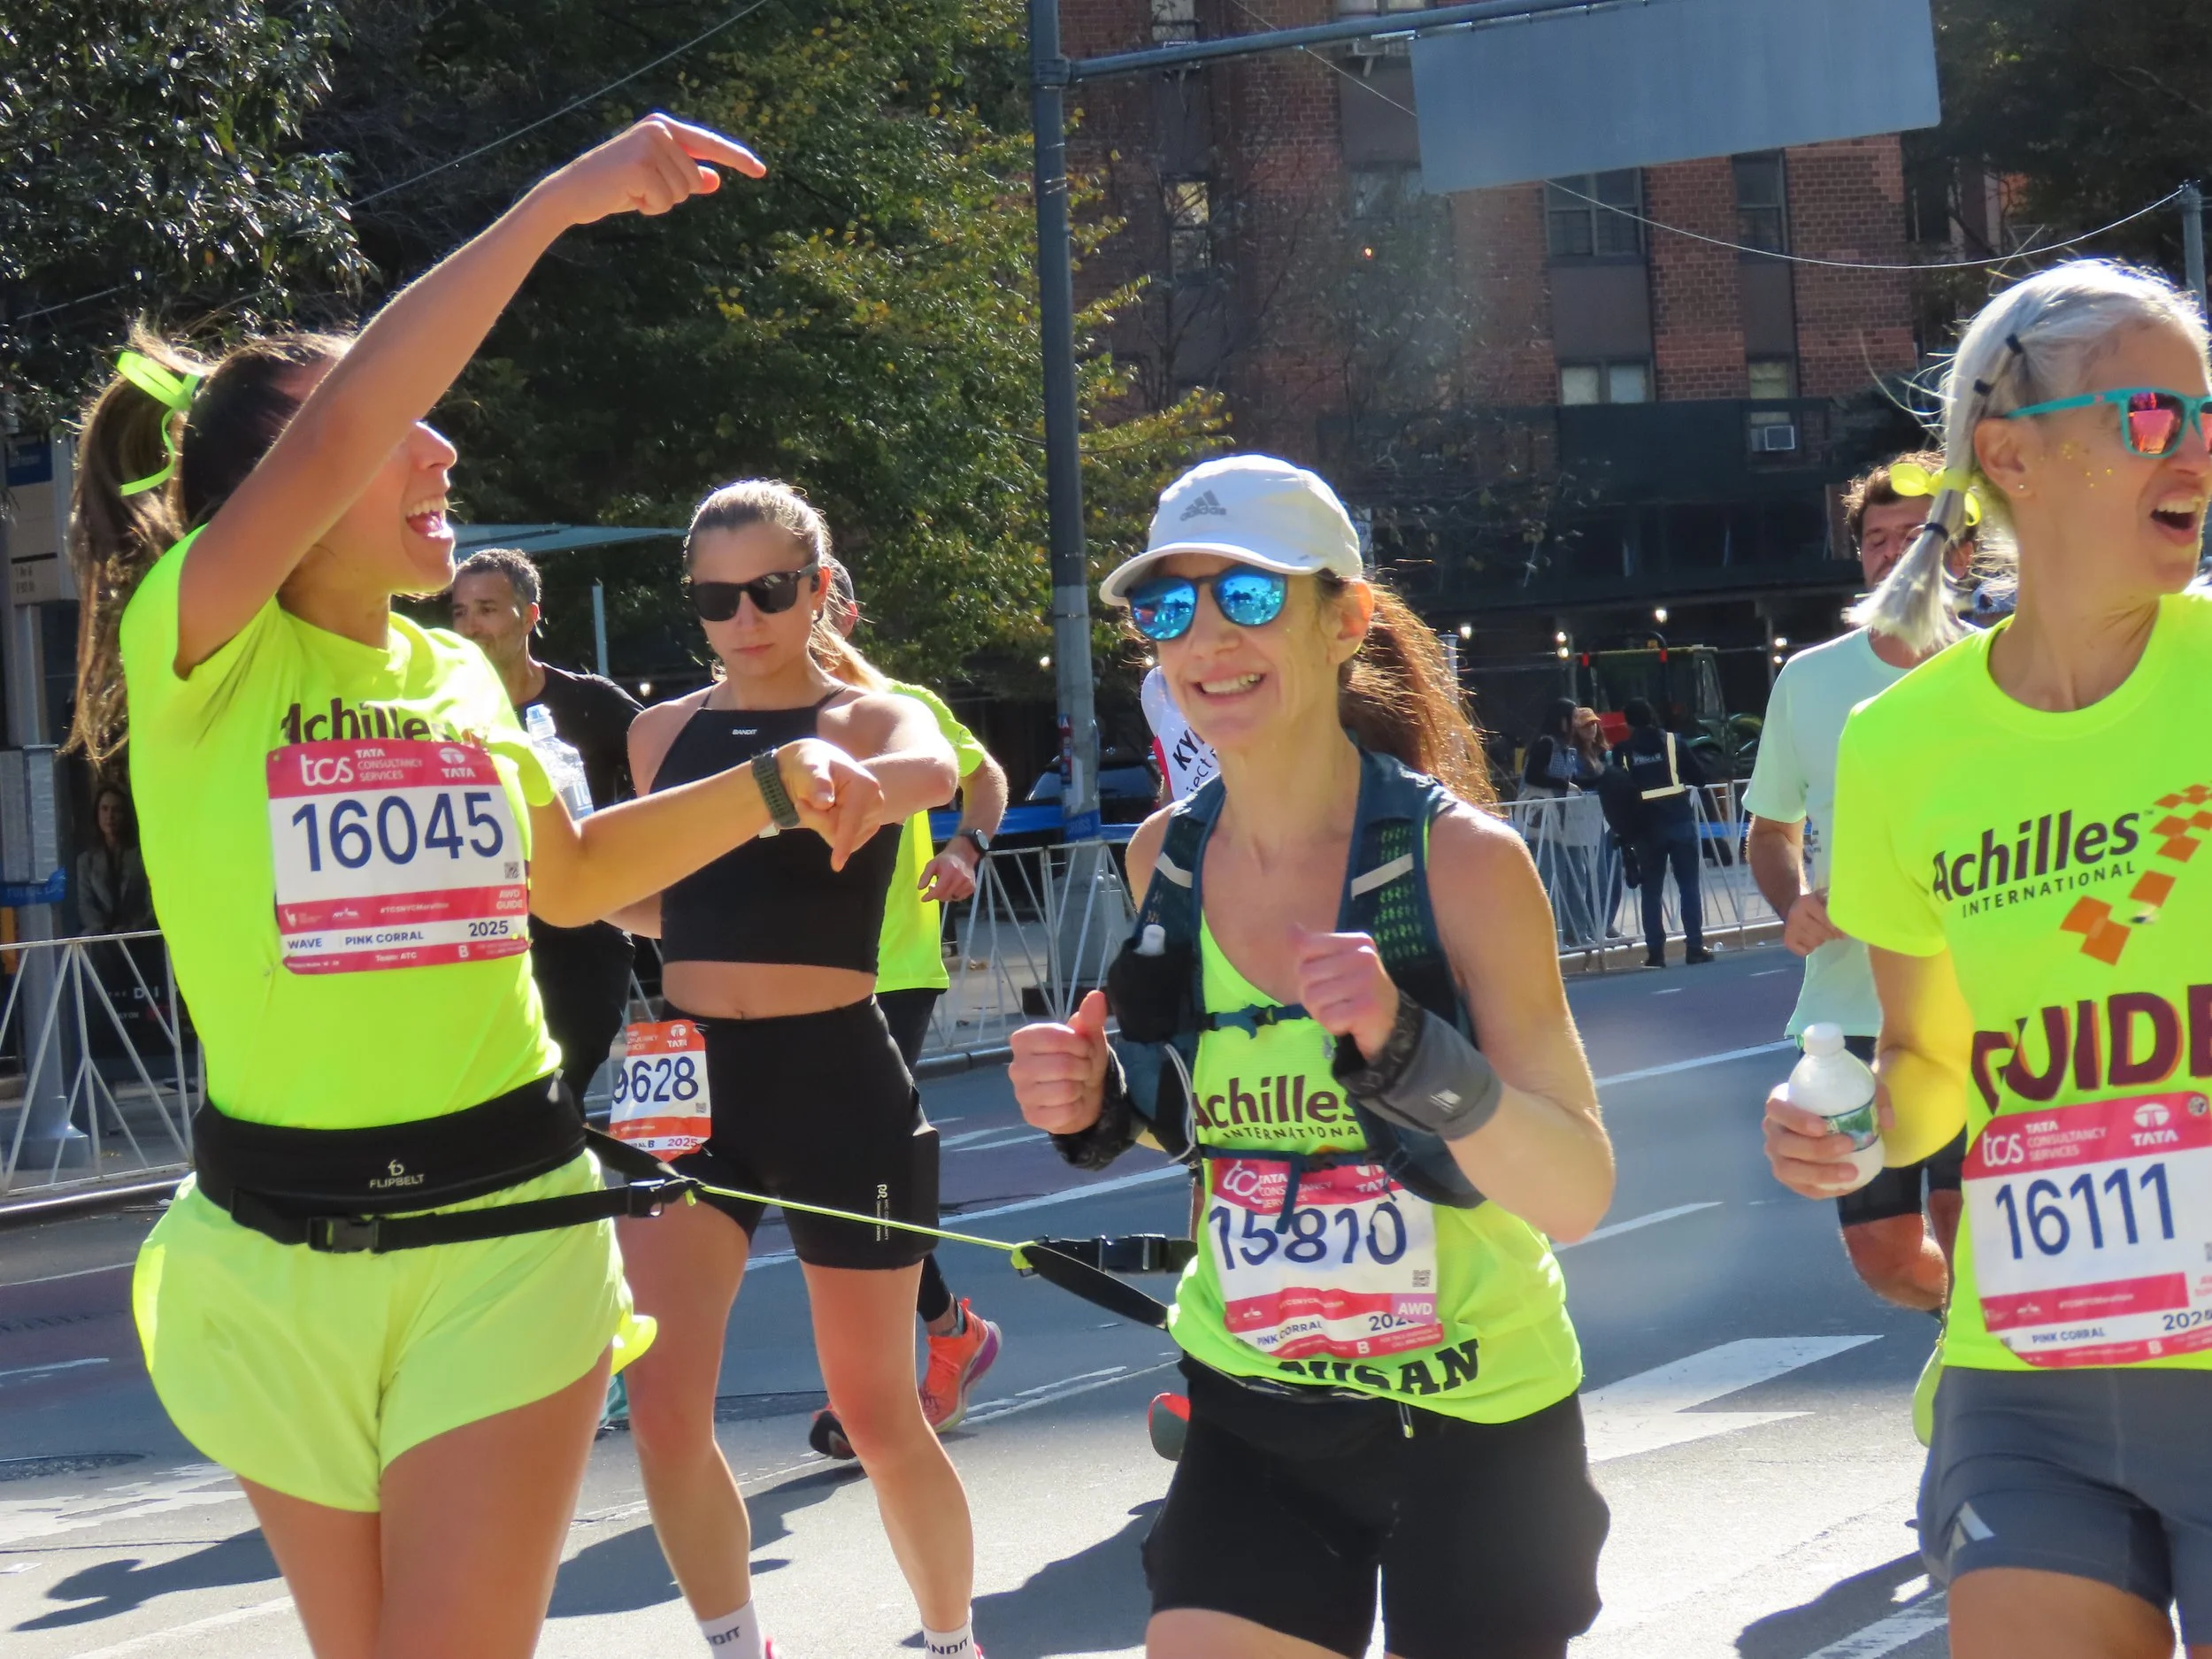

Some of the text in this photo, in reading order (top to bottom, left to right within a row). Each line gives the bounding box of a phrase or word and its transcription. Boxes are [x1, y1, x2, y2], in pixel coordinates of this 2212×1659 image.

[356, 749, 385, 759] TATA
[300, 753, 355, 787] tcs
[360, 770, 403, 782] SERVICES
[441, 767, 476, 779] TATA
[292, 792, 503, 872] 16045
[1932, 809, 2140, 902] Achilles
[1962, 861, 2136, 918] INTERNATIONAL
[496, 900, 524, 911] GUIDE
[468, 920, 509, 938] 2025
[288, 937, 322, 950] WAVE
[345, 931, 424, 947] PINK CORRAL
[1193, 1074, 1356, 1131] Achille
[1222, 1125, 1359, 1140] INTERNATIONA
[2025, 1120, 2058, 1133] TATA
[667, 1138, 698, 1148] 2025
[2027, 1126, 2106, 1148] CONSULTANCY
[2131, 1129, 2178, 1147] TATA
[1983, 1130, 2024, 1167] tcs
[2029, 1146, 2080, 1162] SERVICES
[369, 1173, 424, 1188] FLIPBELT
[1258, 1173, 1288, 1185] TATA
[1995, 1163, 2175, 1260] 16111
[1208, 1200, 1407, 1270] 15810
[1397, 1302, 1433, 1317] AWD
[1369, 1313, 1416, 1332] 202
[1256, 1321, 1324, 1346] PINK CORRAL
[2032, 1328, 2106, 1344] PINK CORRAL
[1356, 1340, 1371, 1355] B
[925, 1636, 969, 1655] ANDIT
